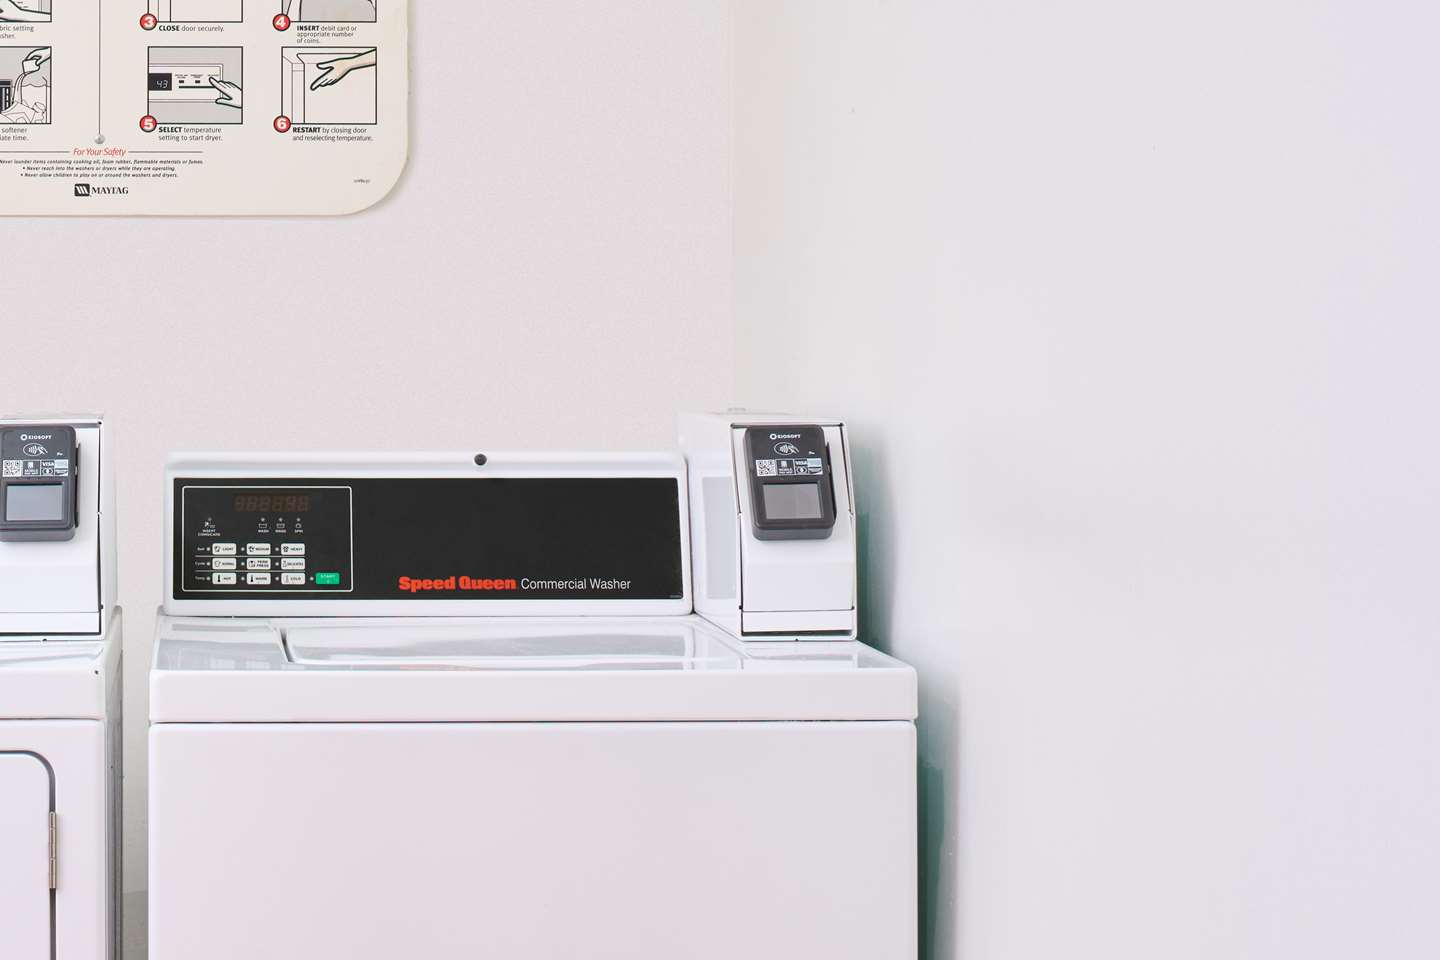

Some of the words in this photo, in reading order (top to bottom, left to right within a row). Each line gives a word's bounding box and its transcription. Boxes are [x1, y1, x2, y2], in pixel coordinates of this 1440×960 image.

[73, 148, 85, 156] For
[86, 148, 102, 156] Your
[103, 147, 127, 157] Safety
[399, 576, 455, 592] Speed
[459, 576, 517, 590] Queen
[521, 578, 586, 590] Commercial
[589, 578, 631, 590] Washer
